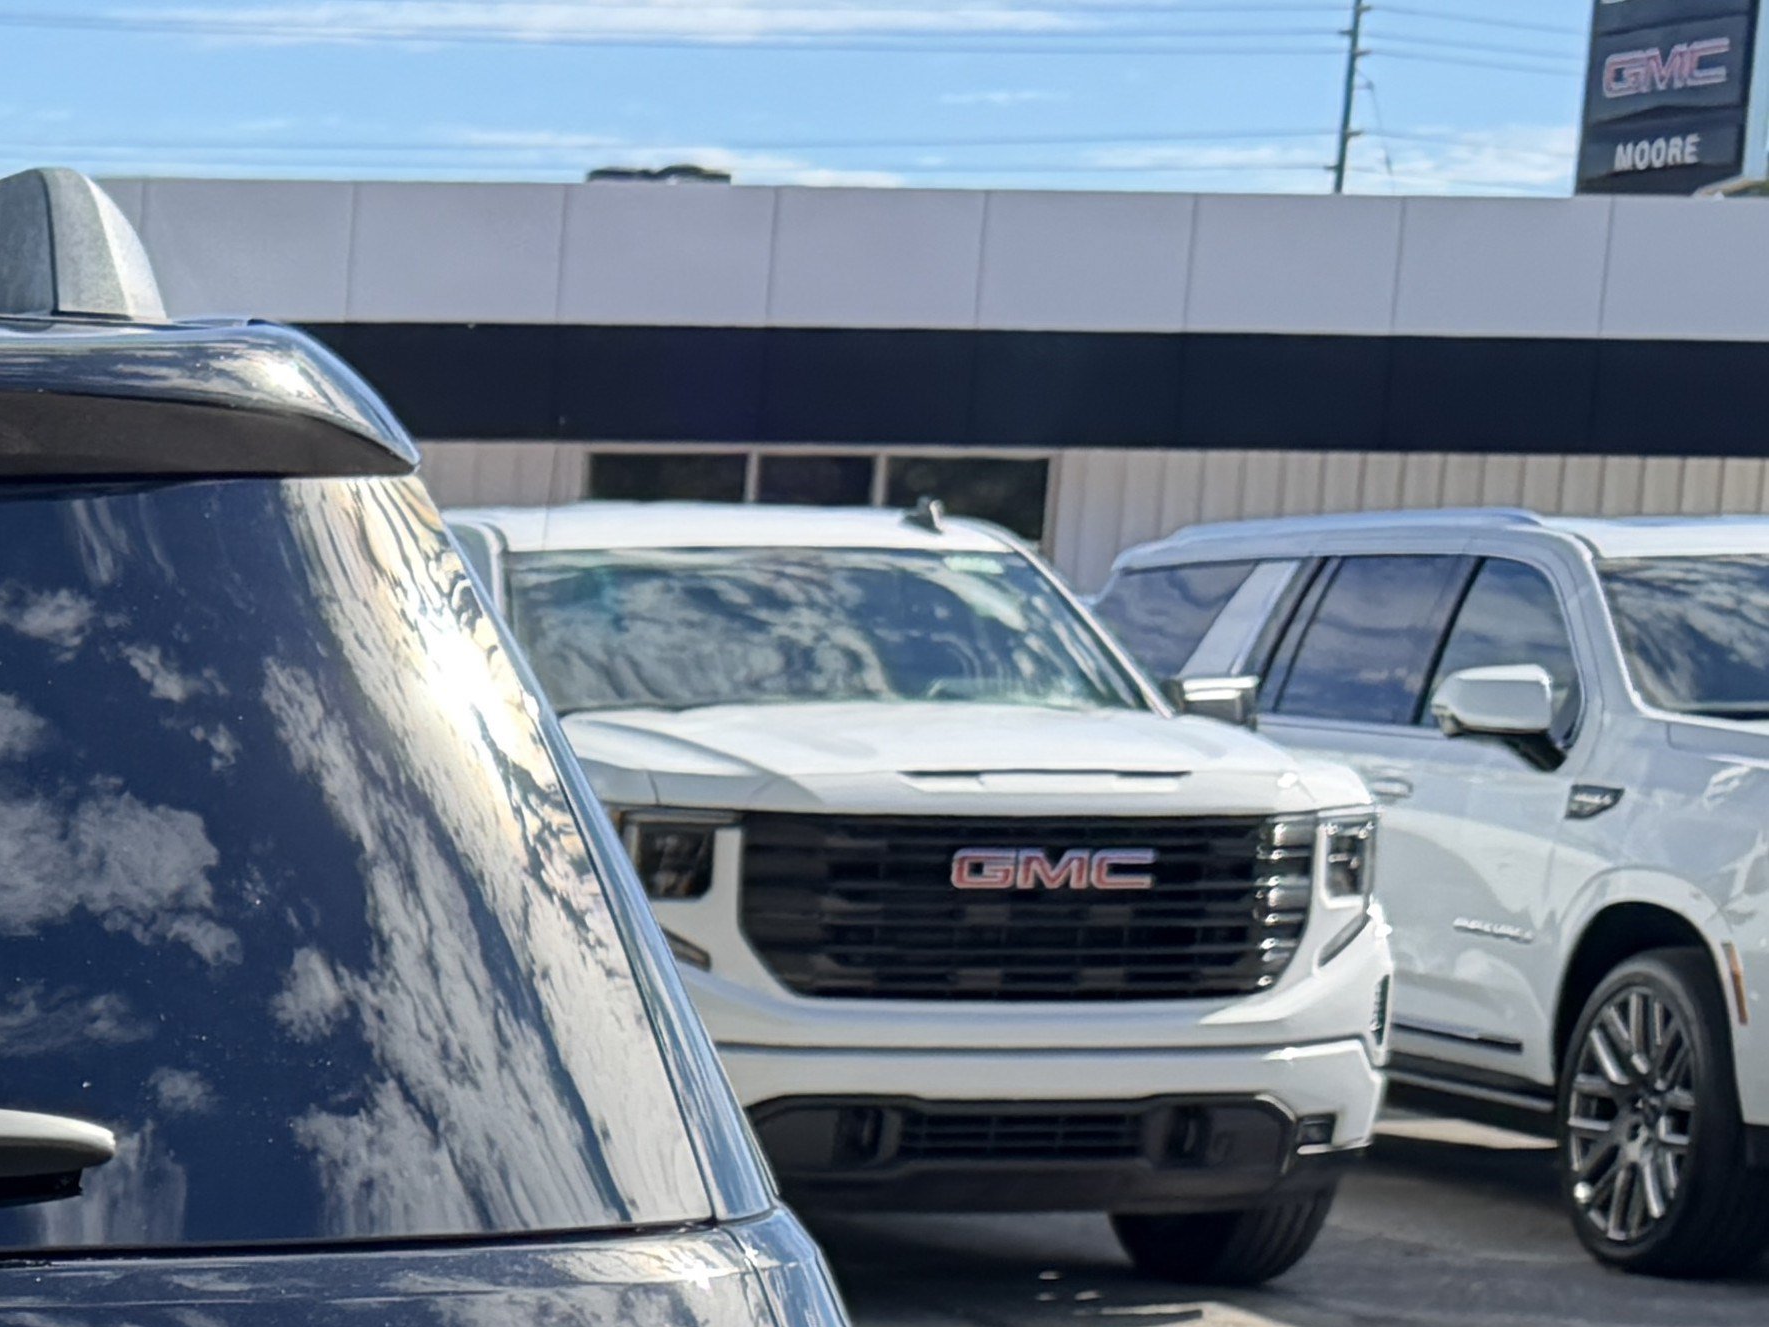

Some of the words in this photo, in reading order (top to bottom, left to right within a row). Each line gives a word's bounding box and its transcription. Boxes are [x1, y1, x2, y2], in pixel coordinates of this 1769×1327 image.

[1603, 37, 1730, 98] GMC
[1614, 133, 1700, 171] MOORE
[951, 848, 1156, 889] GMC
